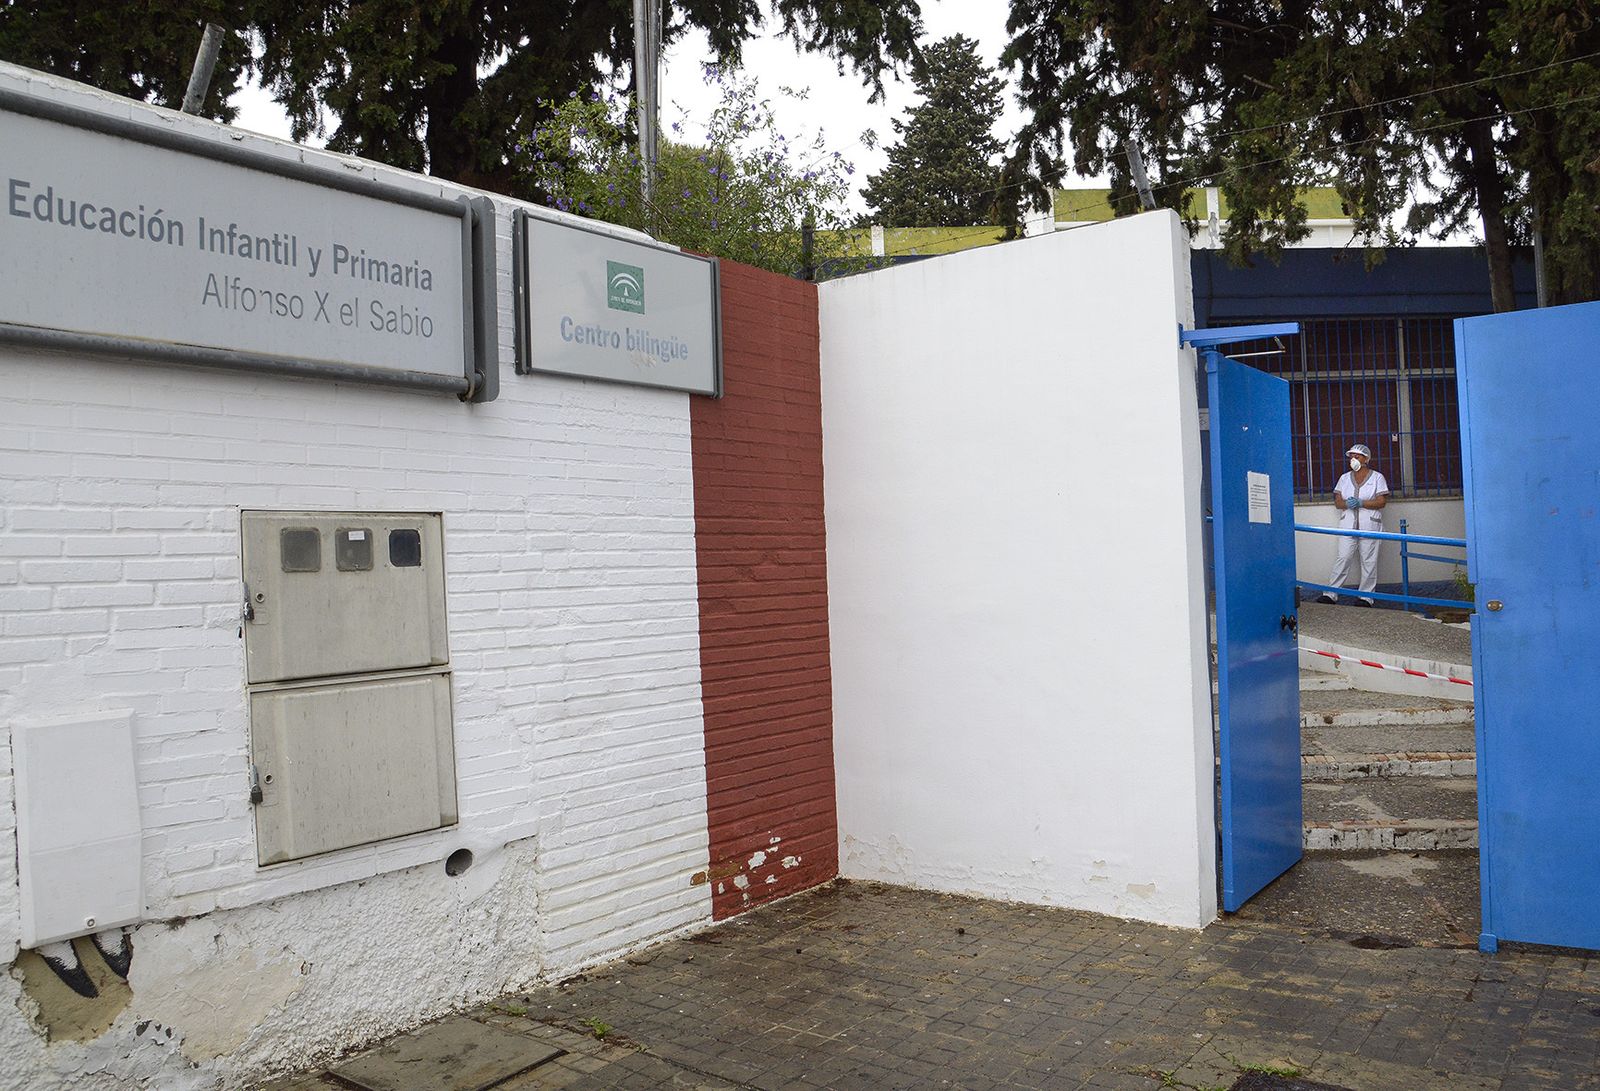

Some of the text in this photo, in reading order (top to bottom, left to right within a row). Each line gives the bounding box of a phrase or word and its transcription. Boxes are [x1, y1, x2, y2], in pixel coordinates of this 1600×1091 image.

[9, 179, 433, 291] Educación Infantil y Primaria
[202, 272, 434, 338] Alfonso X el Sabio
[560, 315, 688, 363] Centro bilingüe
